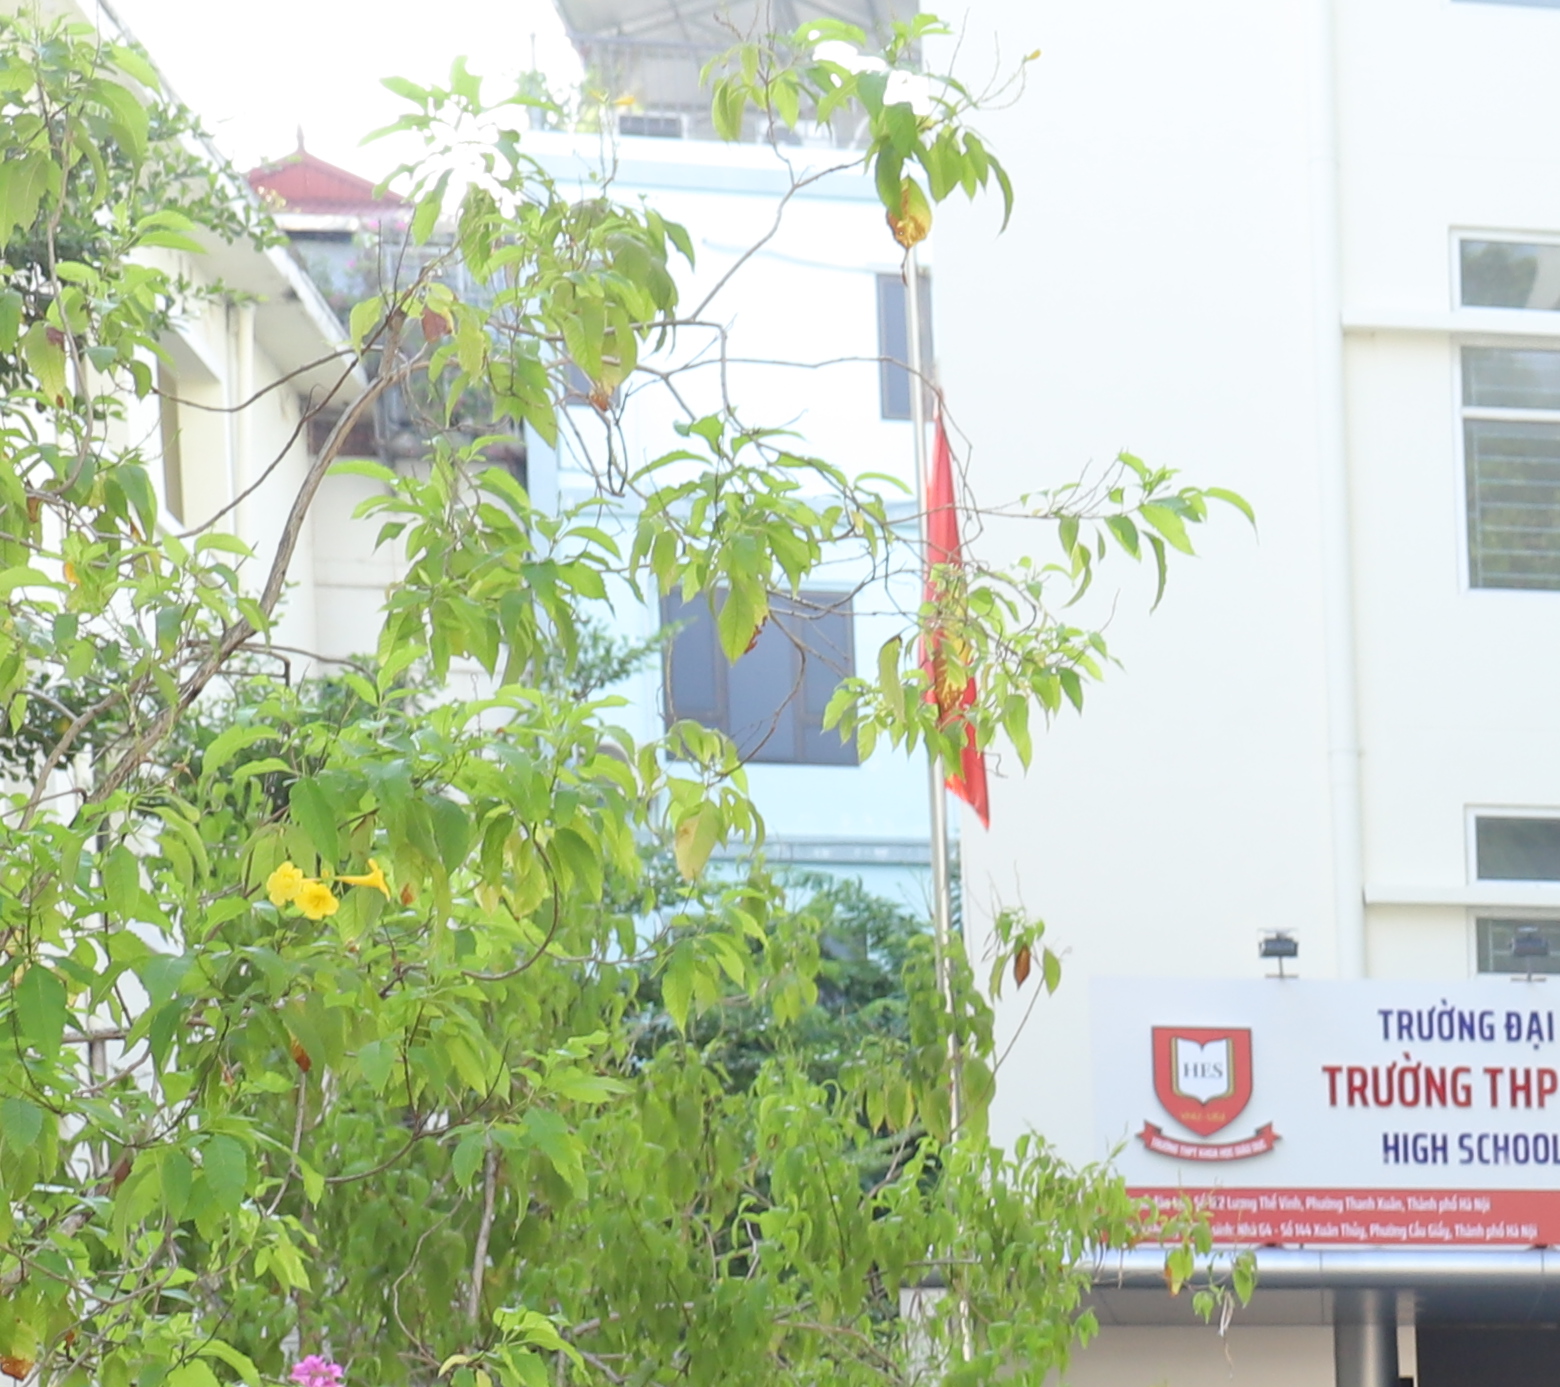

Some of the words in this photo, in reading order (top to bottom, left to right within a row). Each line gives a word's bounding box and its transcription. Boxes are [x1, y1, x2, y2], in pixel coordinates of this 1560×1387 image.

[1378, 998, 1496, 1042] TRƯỜNG
[1504, 1010, 1554, 1051] ĐẠI
[1183, 1062, 1224, 1080] HES
[1321, 1051, 1473, 1108] TRƯỜNG
[1382, 1132, 1449, 1165] HIGH
